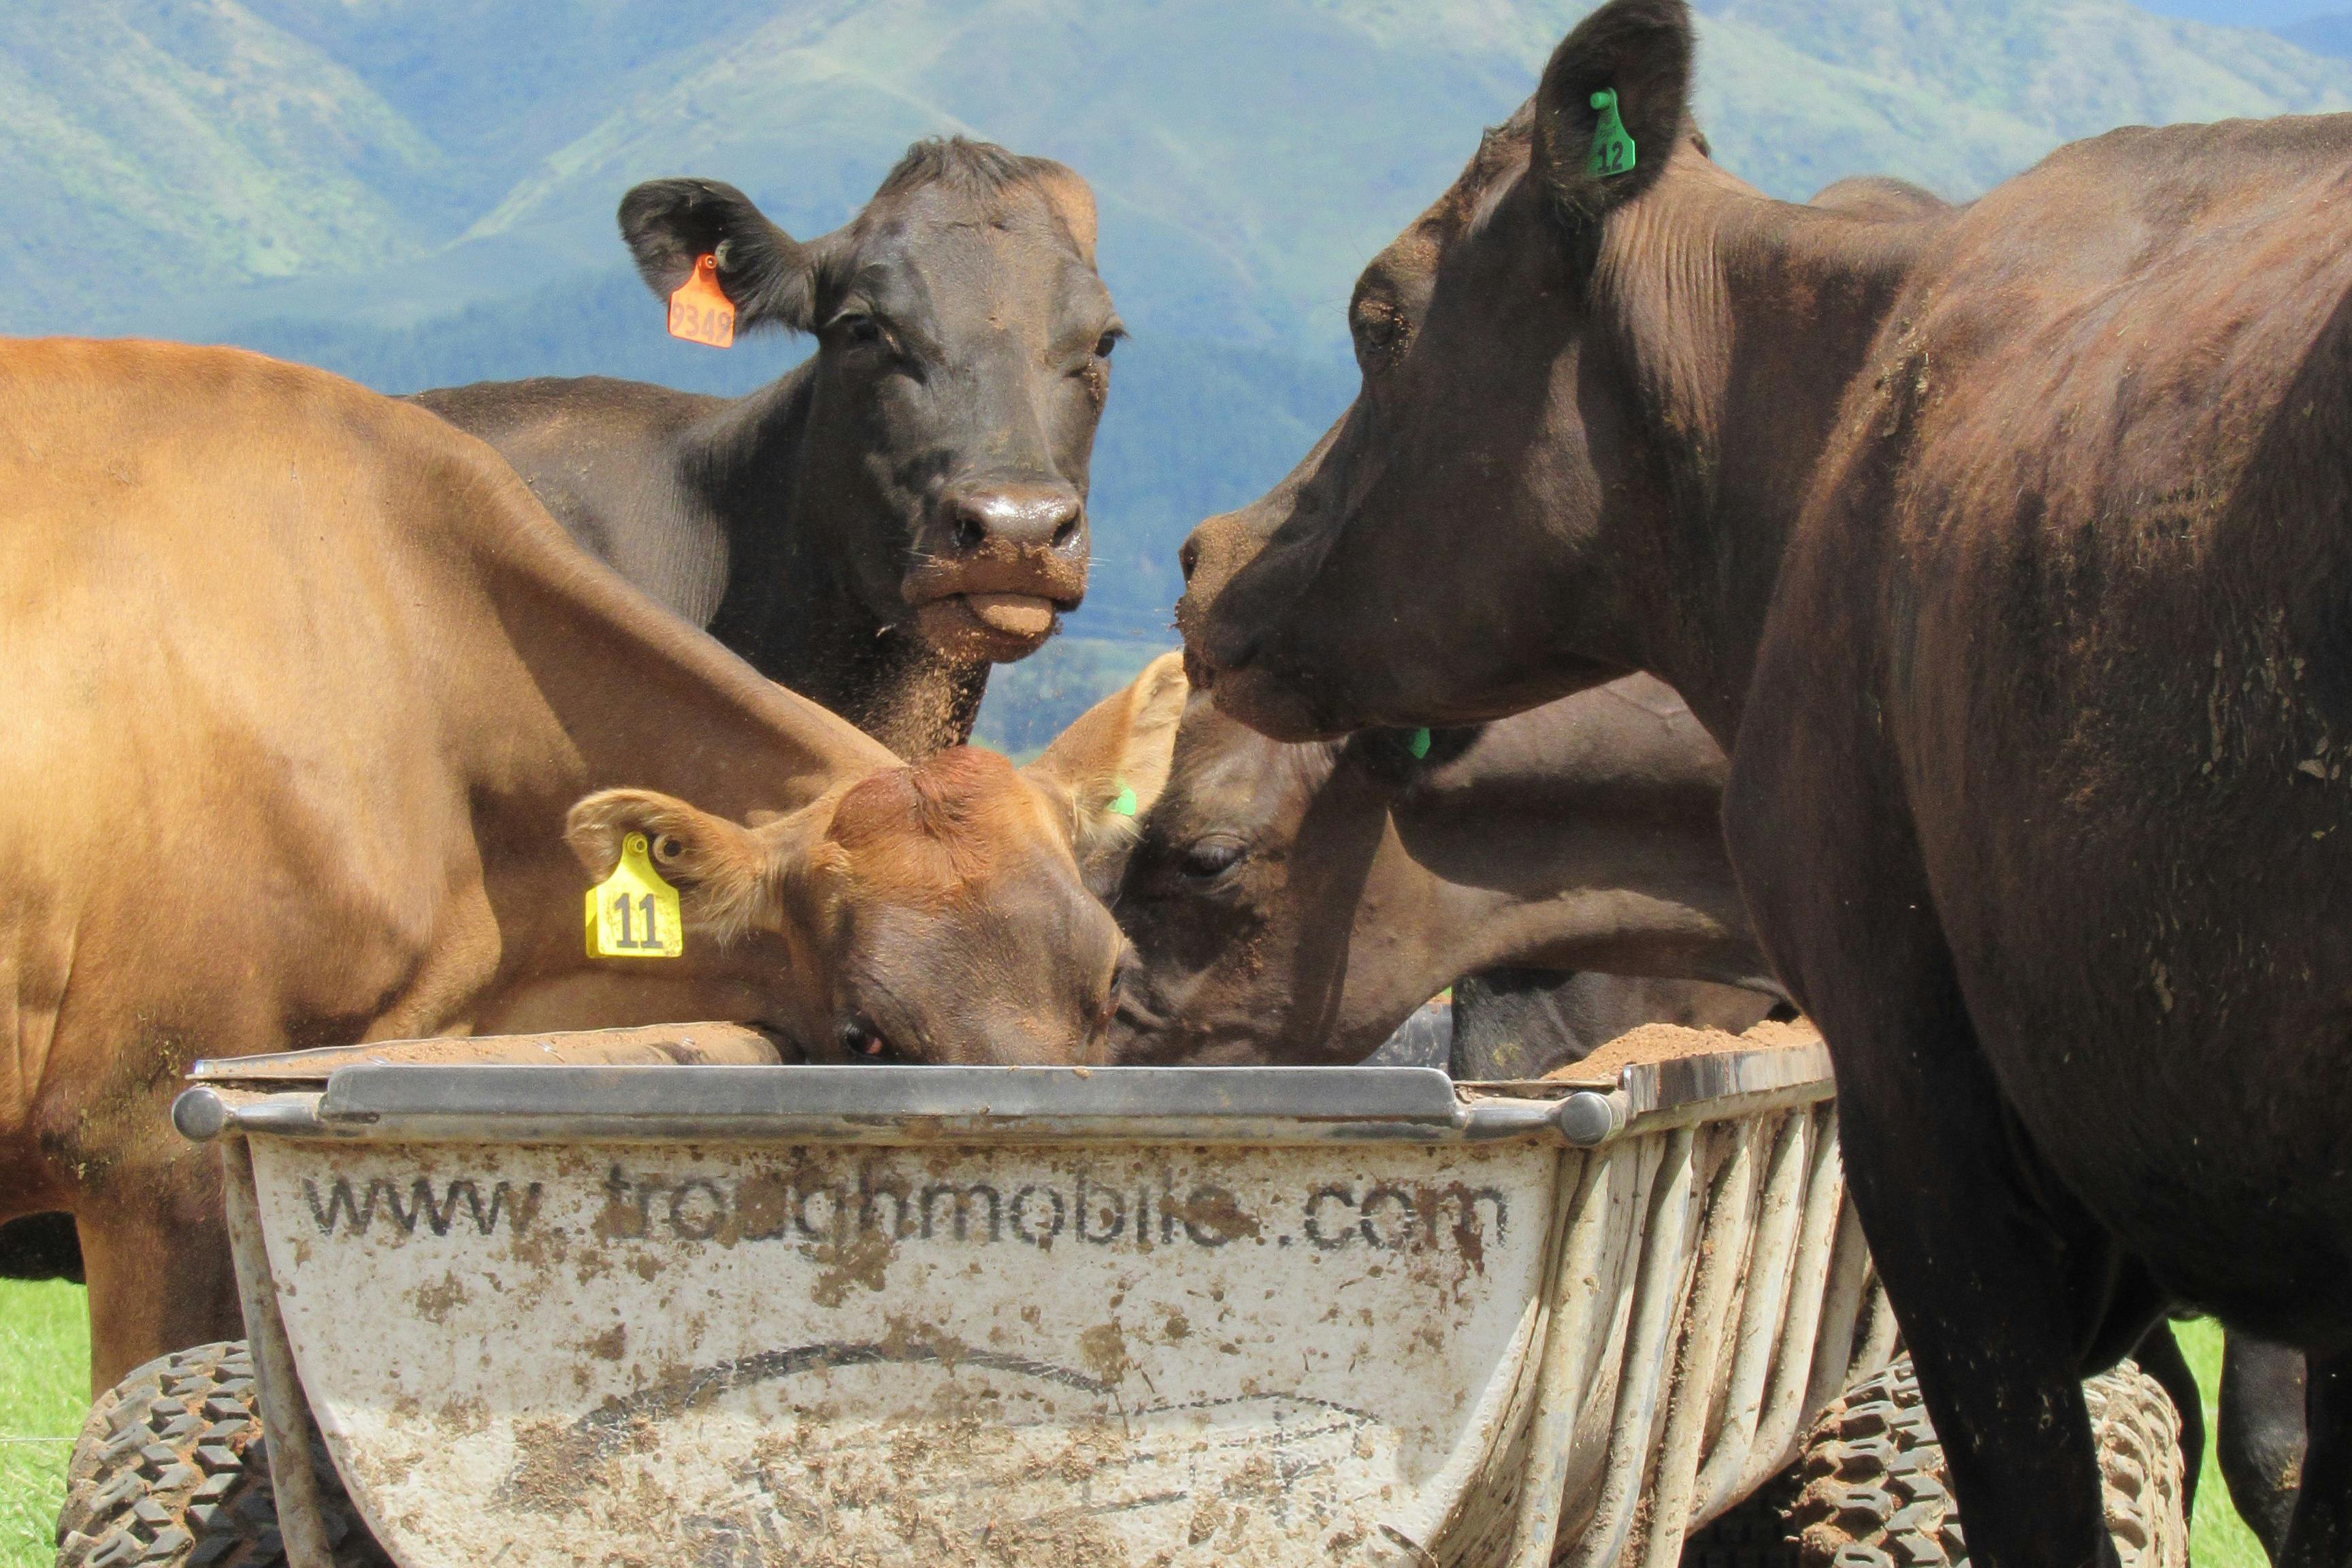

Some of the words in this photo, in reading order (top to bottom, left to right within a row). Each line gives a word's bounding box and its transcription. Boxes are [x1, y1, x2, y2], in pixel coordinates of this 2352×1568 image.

[1598, 141, 1623, 174] 12
[672, 303, 732, 342] 9349
[614, 892, 664, 949] 11
[303, 1159, 1507, 1259] www.troghmobile.com
